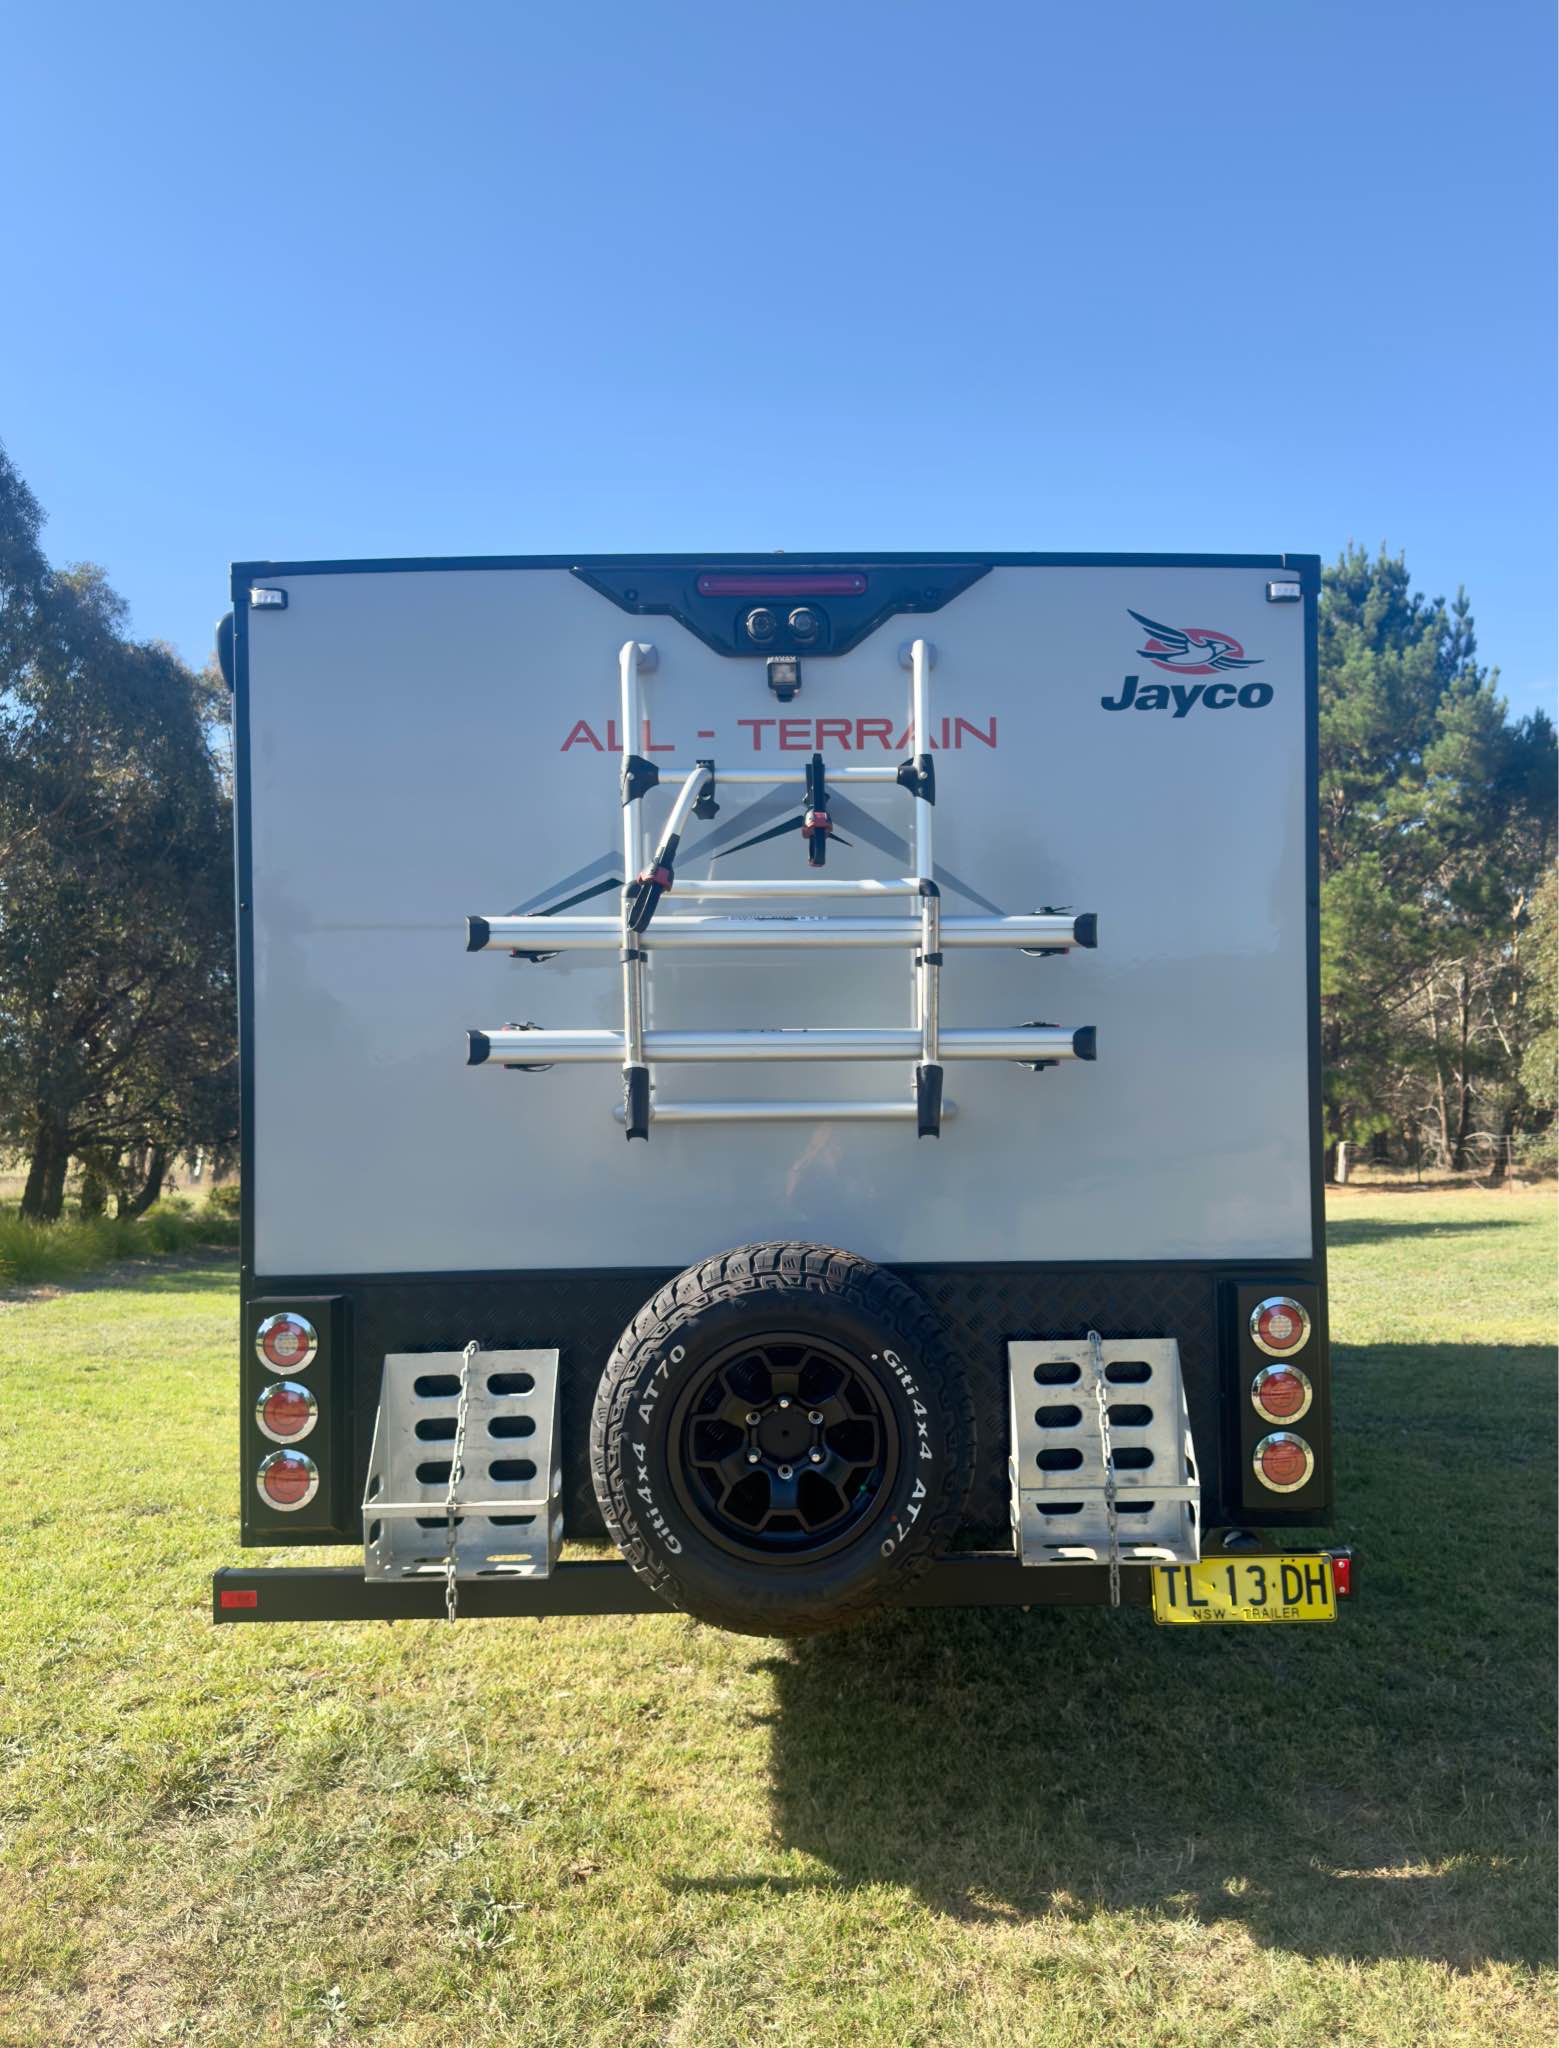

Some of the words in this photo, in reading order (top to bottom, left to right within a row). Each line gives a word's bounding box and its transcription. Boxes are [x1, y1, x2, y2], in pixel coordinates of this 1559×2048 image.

[1100, 675, 1274, 718] Jayco
[559, 719, 676, 752] ALL
[1192, 1608, 1226, 1620] NSW
[1242, 1607, 1300, 1620] TRAILER
